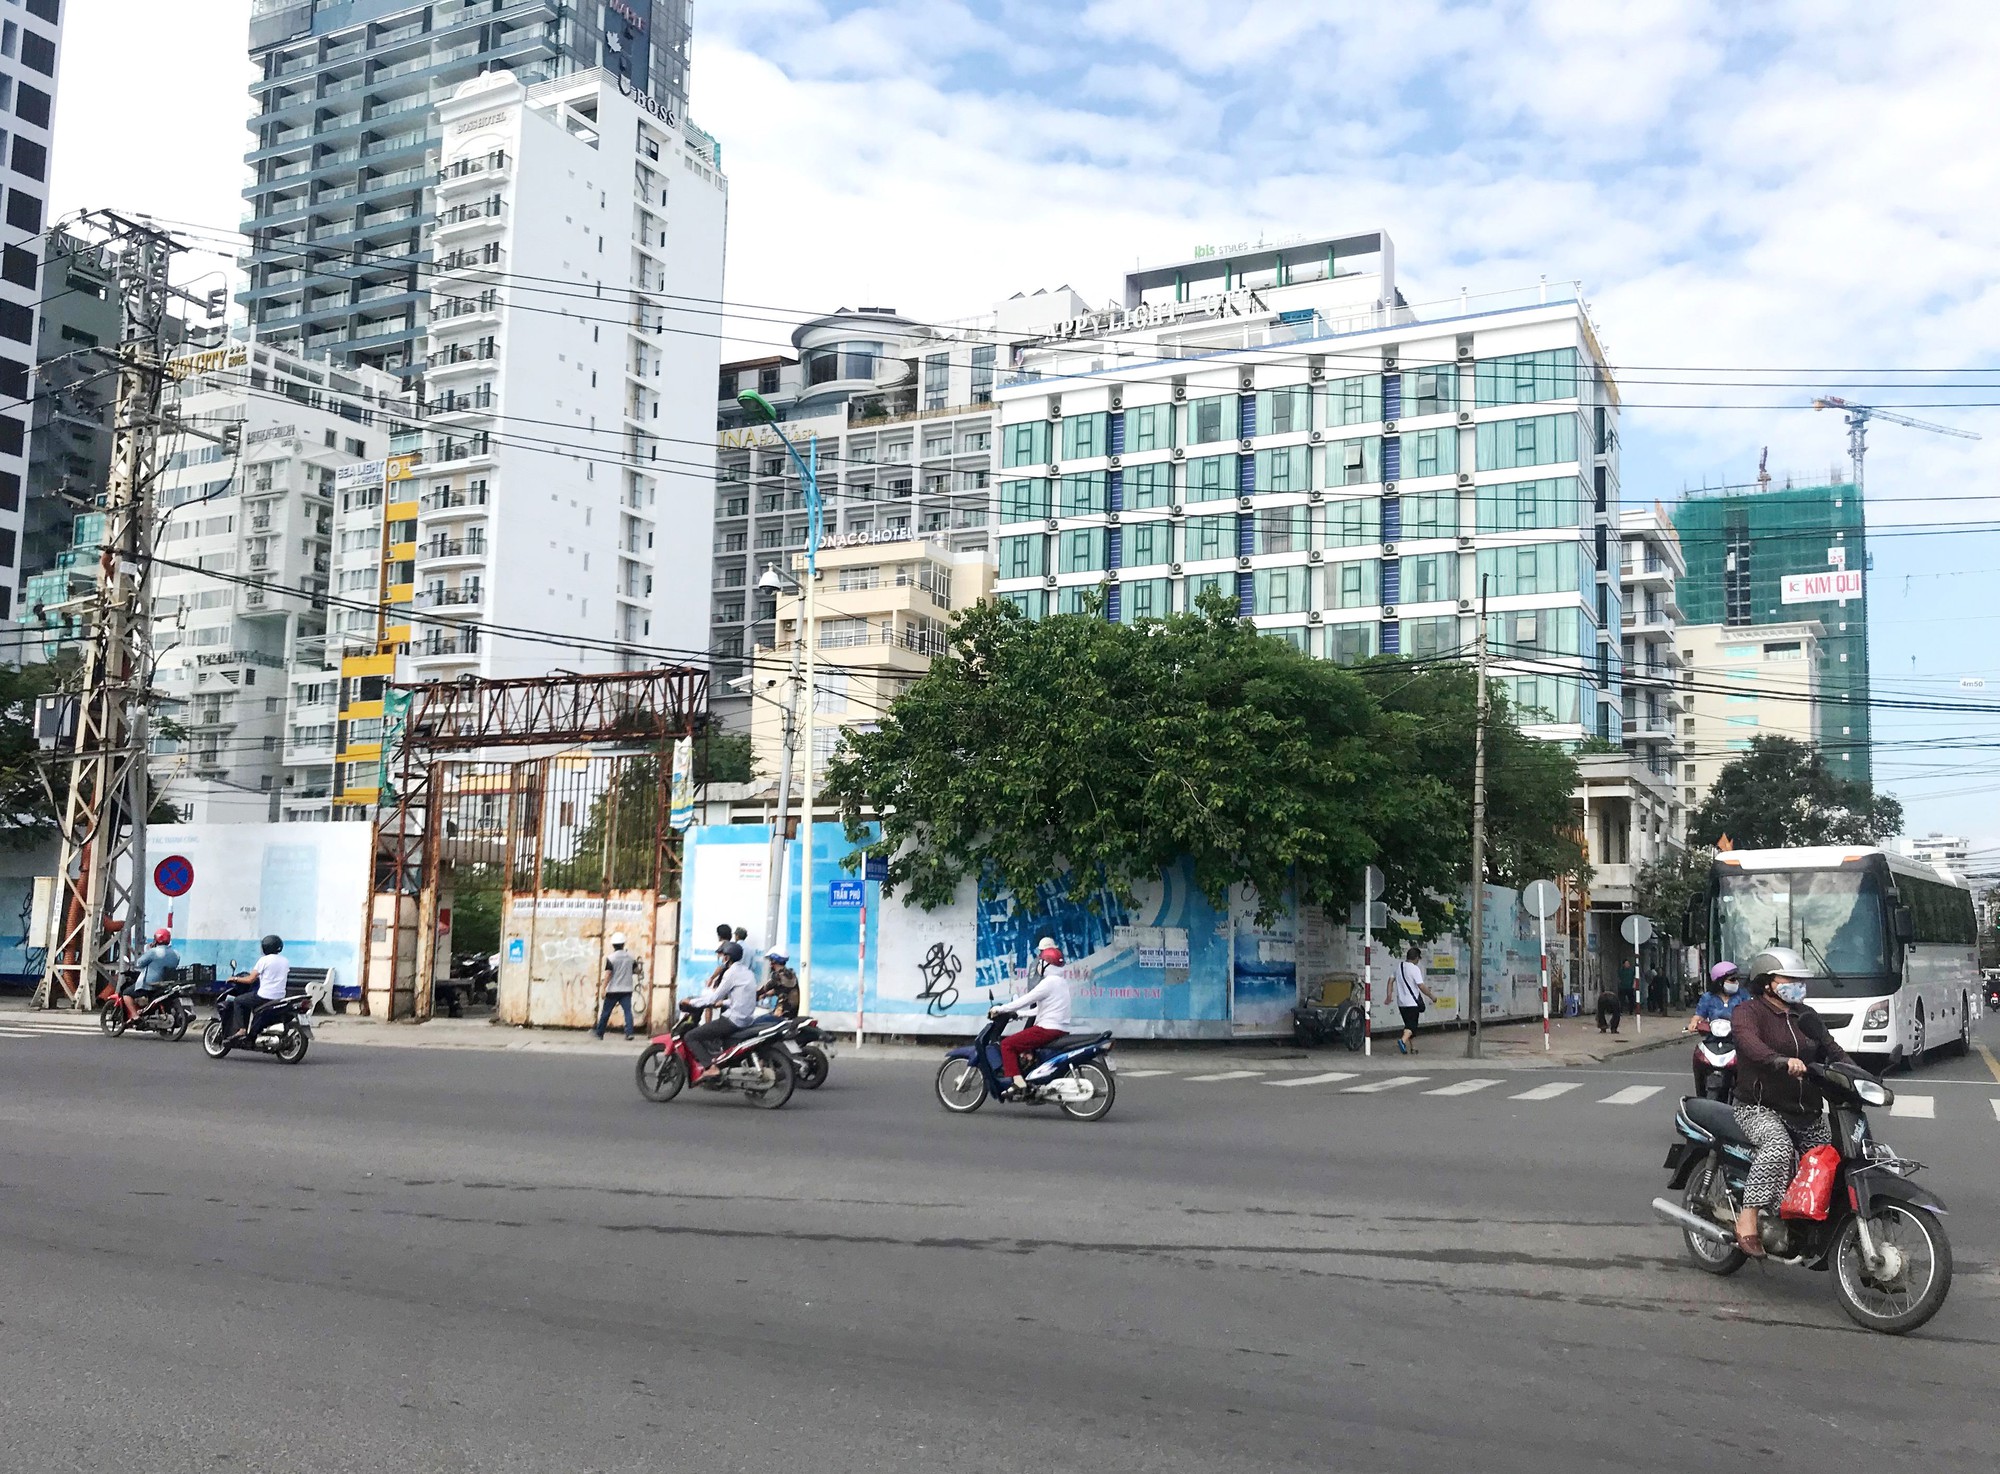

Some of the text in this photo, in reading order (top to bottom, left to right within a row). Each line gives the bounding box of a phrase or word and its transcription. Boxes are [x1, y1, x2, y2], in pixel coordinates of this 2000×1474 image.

[635, 88, 676, 128] BOSS
[478, 112, 507, 129] HOTEL
[193, 350, 228, 374] CITY
[338, 465, 356, 480] SEA
[358, 460, 385, 476] LIGHT
[872, 526, 912, 544] HOTEL
[1805, 575, 1831, 595] KIM
